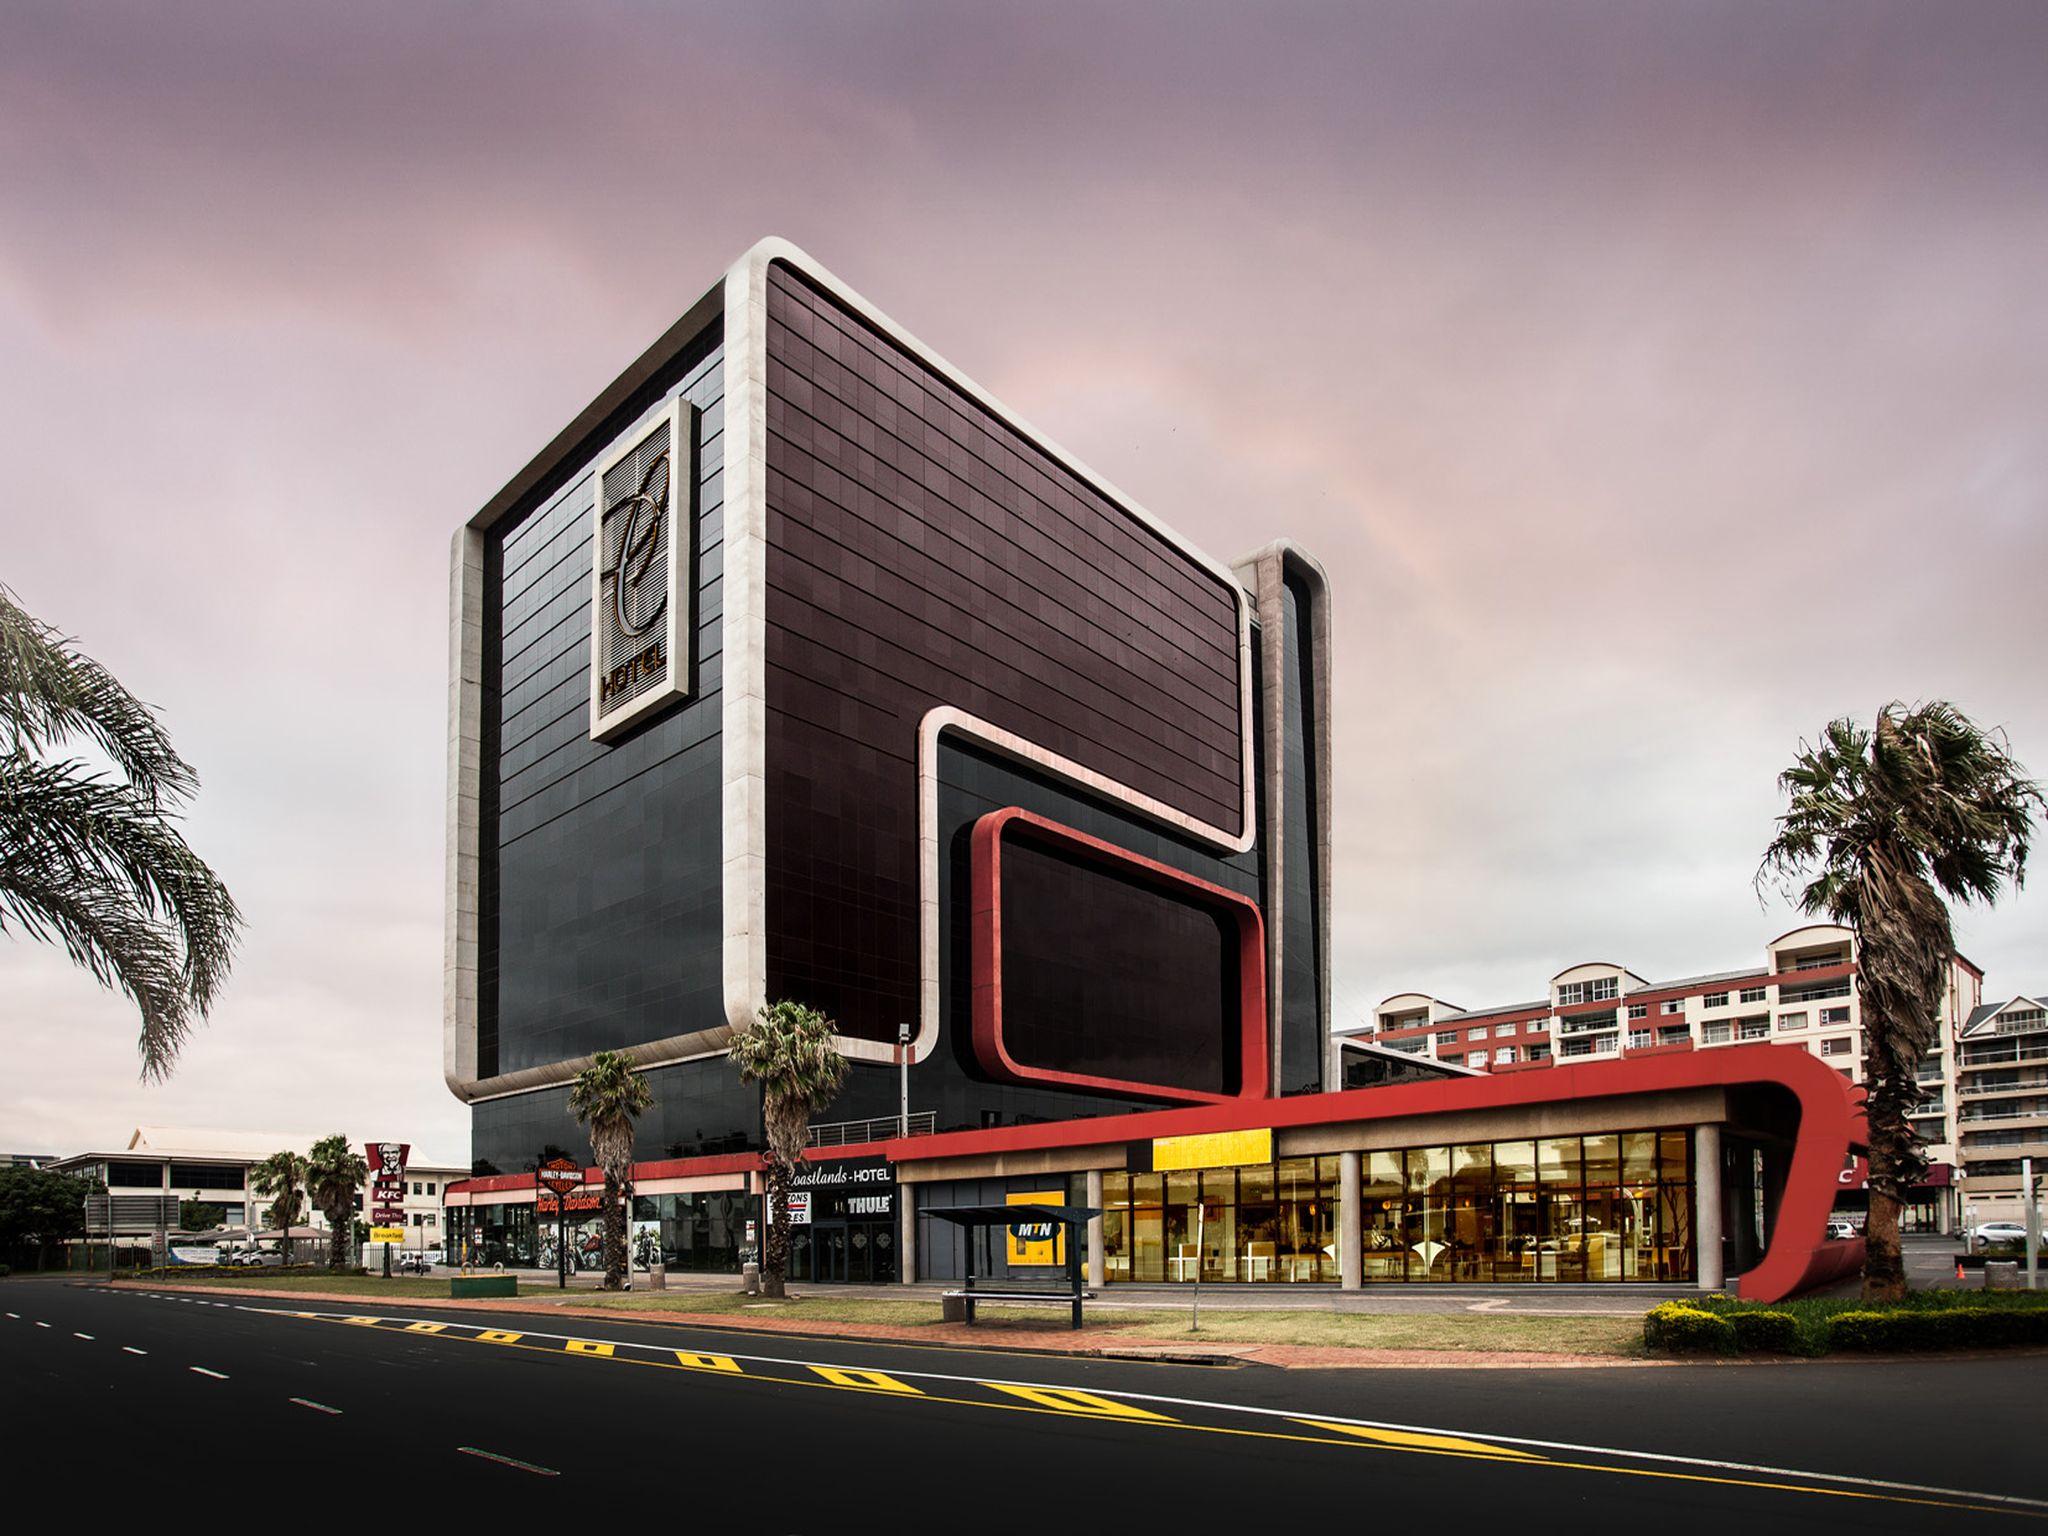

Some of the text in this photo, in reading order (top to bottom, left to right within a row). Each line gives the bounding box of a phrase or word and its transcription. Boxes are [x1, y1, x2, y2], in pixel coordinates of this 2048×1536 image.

[601, 642, 667, 702] HOTEL
[792, 1165, 848, 1187] oastlands
[377, 1190, 401, 1199] KFC
[847, 1195, 890, 1214] THULE
[1018, 1222, 1052, 1236] MTN
